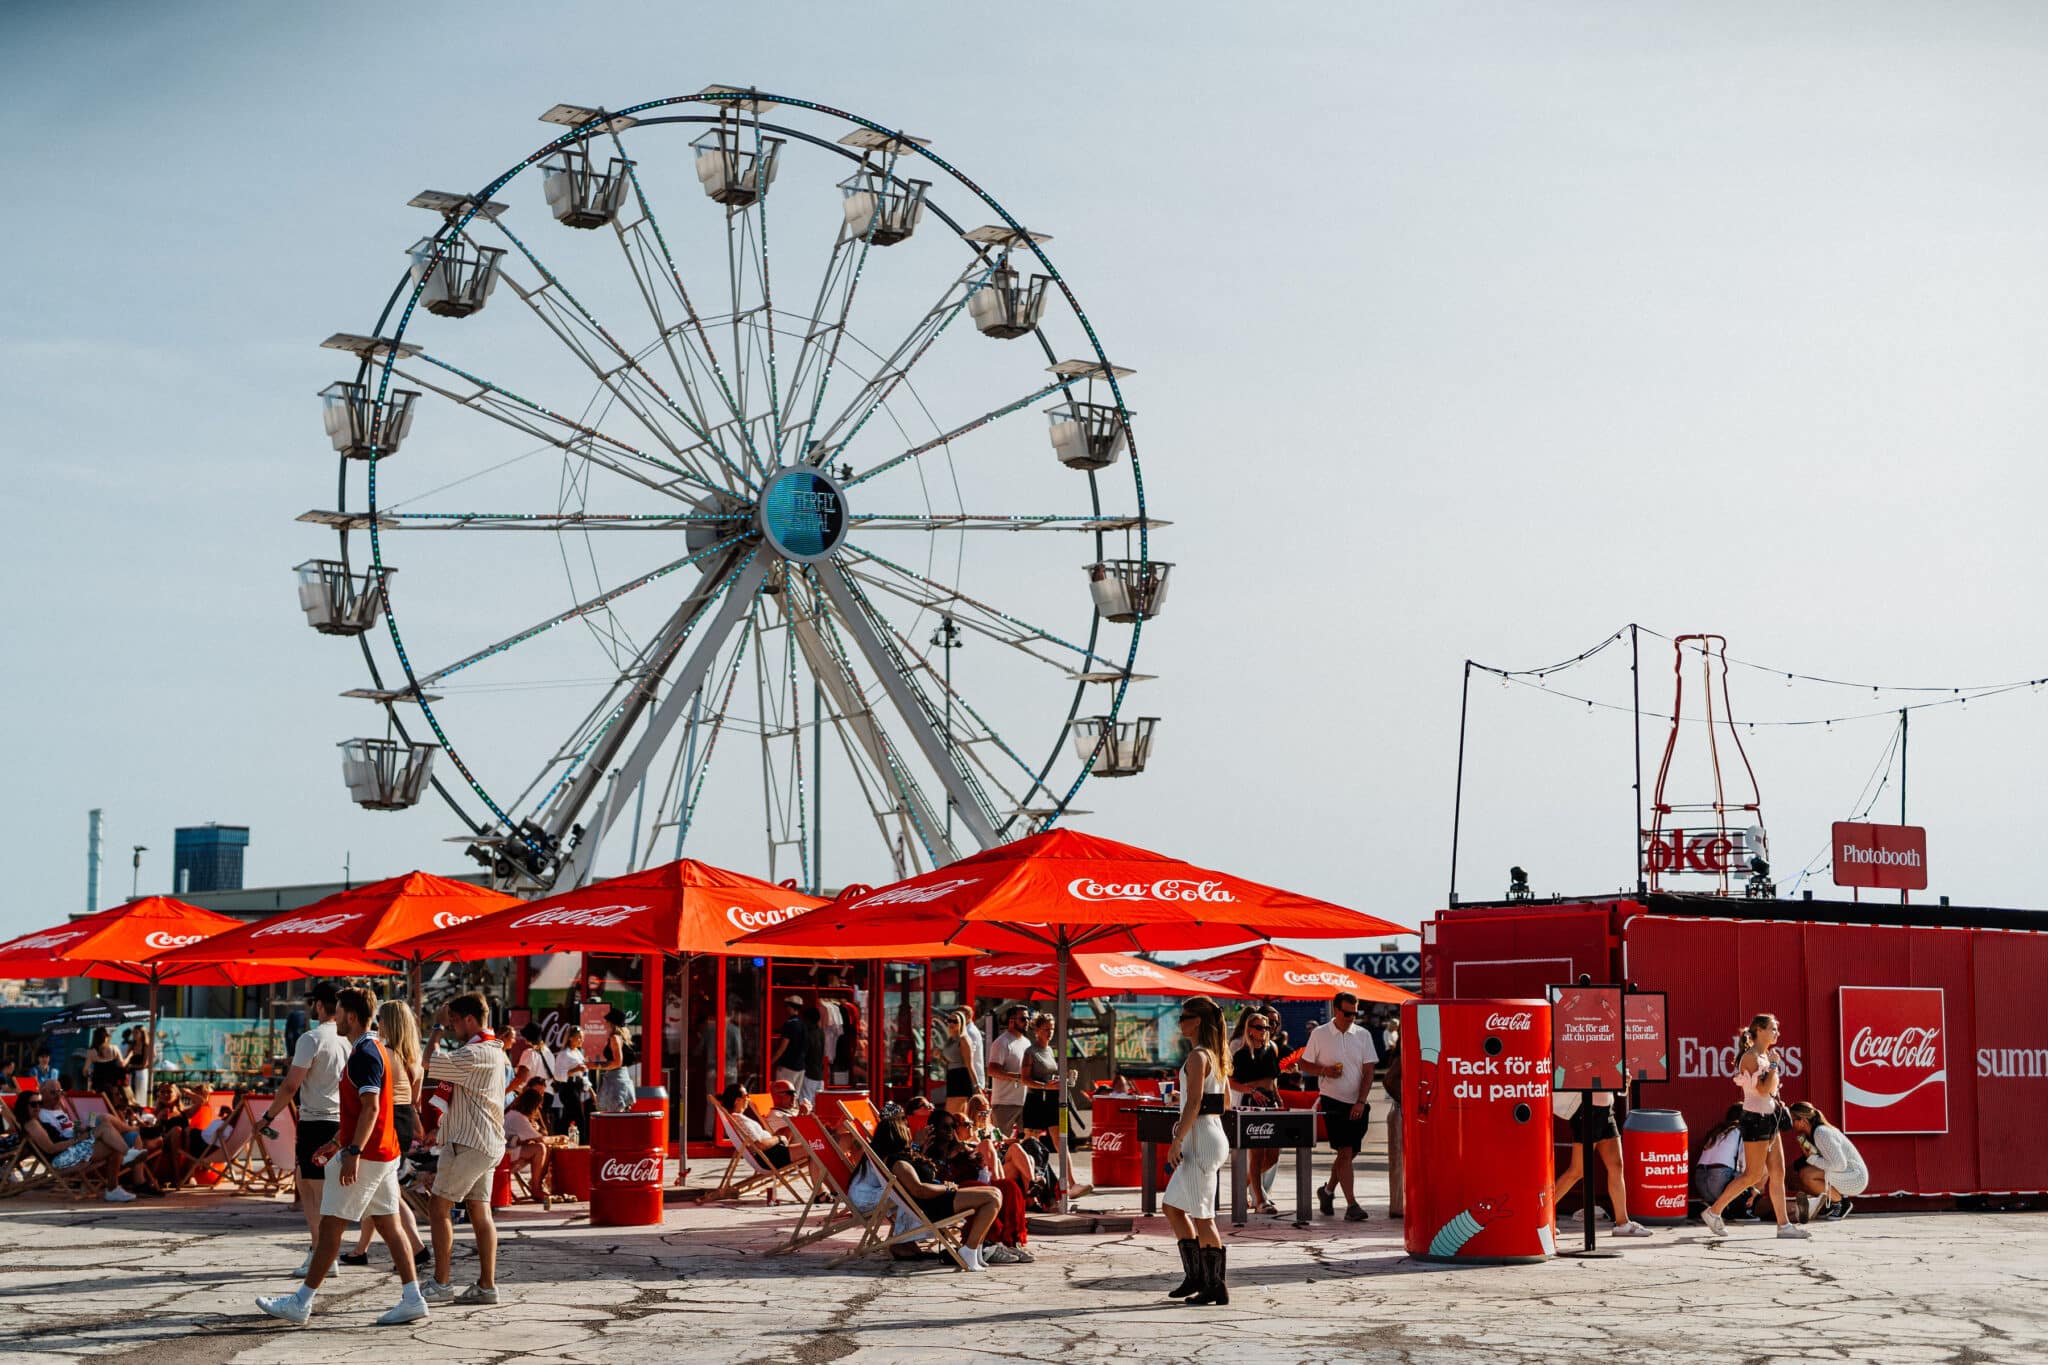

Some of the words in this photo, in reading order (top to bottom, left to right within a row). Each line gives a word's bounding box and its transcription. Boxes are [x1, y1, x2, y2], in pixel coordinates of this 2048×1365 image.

[1641, 829, 1733, 873] oke
[1843, 844, 1921, 867] Photobooth
[1067, 878, 1237, 903] Coca-Cola
[1283, 970, 1359, 989] Coca-Cola
[1485, 1012, 1533, 1031] Coca-Cola
[1564, 1023, 1584, 1033] Tack
[1585, 1023, 1597, 1033] för
[1598, 1023, 1610, 1033] att
[1632, 1024, 1643, 1033] för
[1562, 1033, 1573, 1041] att
[1574, 1033, 1585, 1041] du
[1585, 1033, 1615, 1043] pantar!
[1632, 1033, 1659, 1041] pantar!
[1849, 1026, 1940, 1068] Coca-Cola
[1447, 1057, 1500, 1075] Tack
[1504, 1057, 1532, 1075] för
[1535, 1057, 1551, 1074] att
[1678, 1036, 1803, 1078] Endss
[1453, 1080, 1482, 1098] du
[1489, 1080, 1550, 1102] pantar!
[1640, 1151, 1681, 1162] Lämna
[600, 1157, 661, 1182] Coca-Cola
[1645, 1164, 1675, 1177] pant
[1655, 1194, 1687, 1209] Coca-Cola
